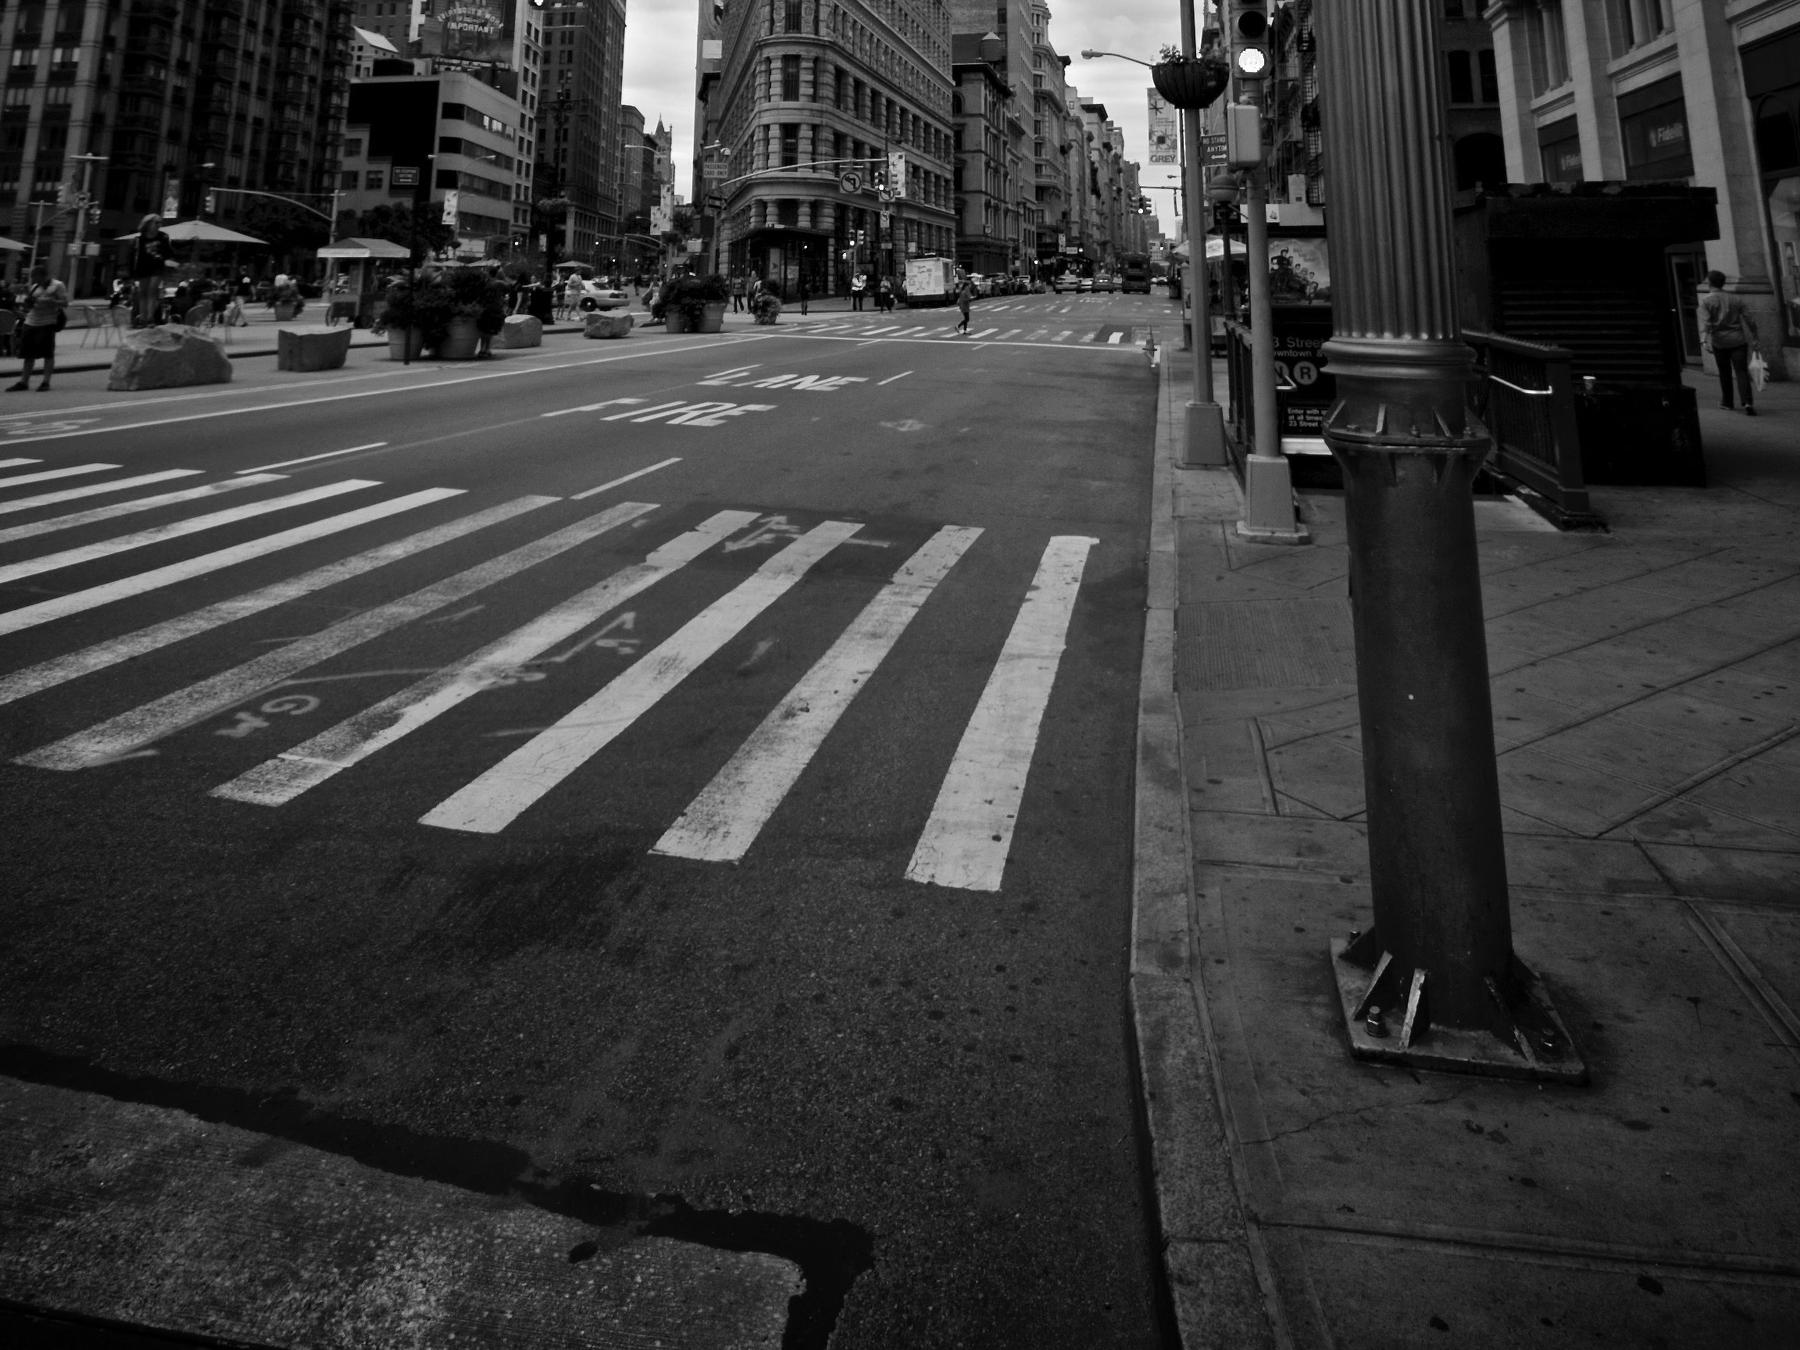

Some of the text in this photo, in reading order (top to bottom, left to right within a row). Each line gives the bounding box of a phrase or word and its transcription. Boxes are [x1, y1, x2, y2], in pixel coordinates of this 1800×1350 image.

[447, 21, 494, 35] IMPORTANT
[1150, 153, 1177, 164] GREY
[1299, 366, 1312, 380] R
[695, 371, 870, 392] LANE
[541, 397, 778, 427] FIRE
[1287, 407, 1304, 415] Enter
[1298, 420, 1319, 428] Street
